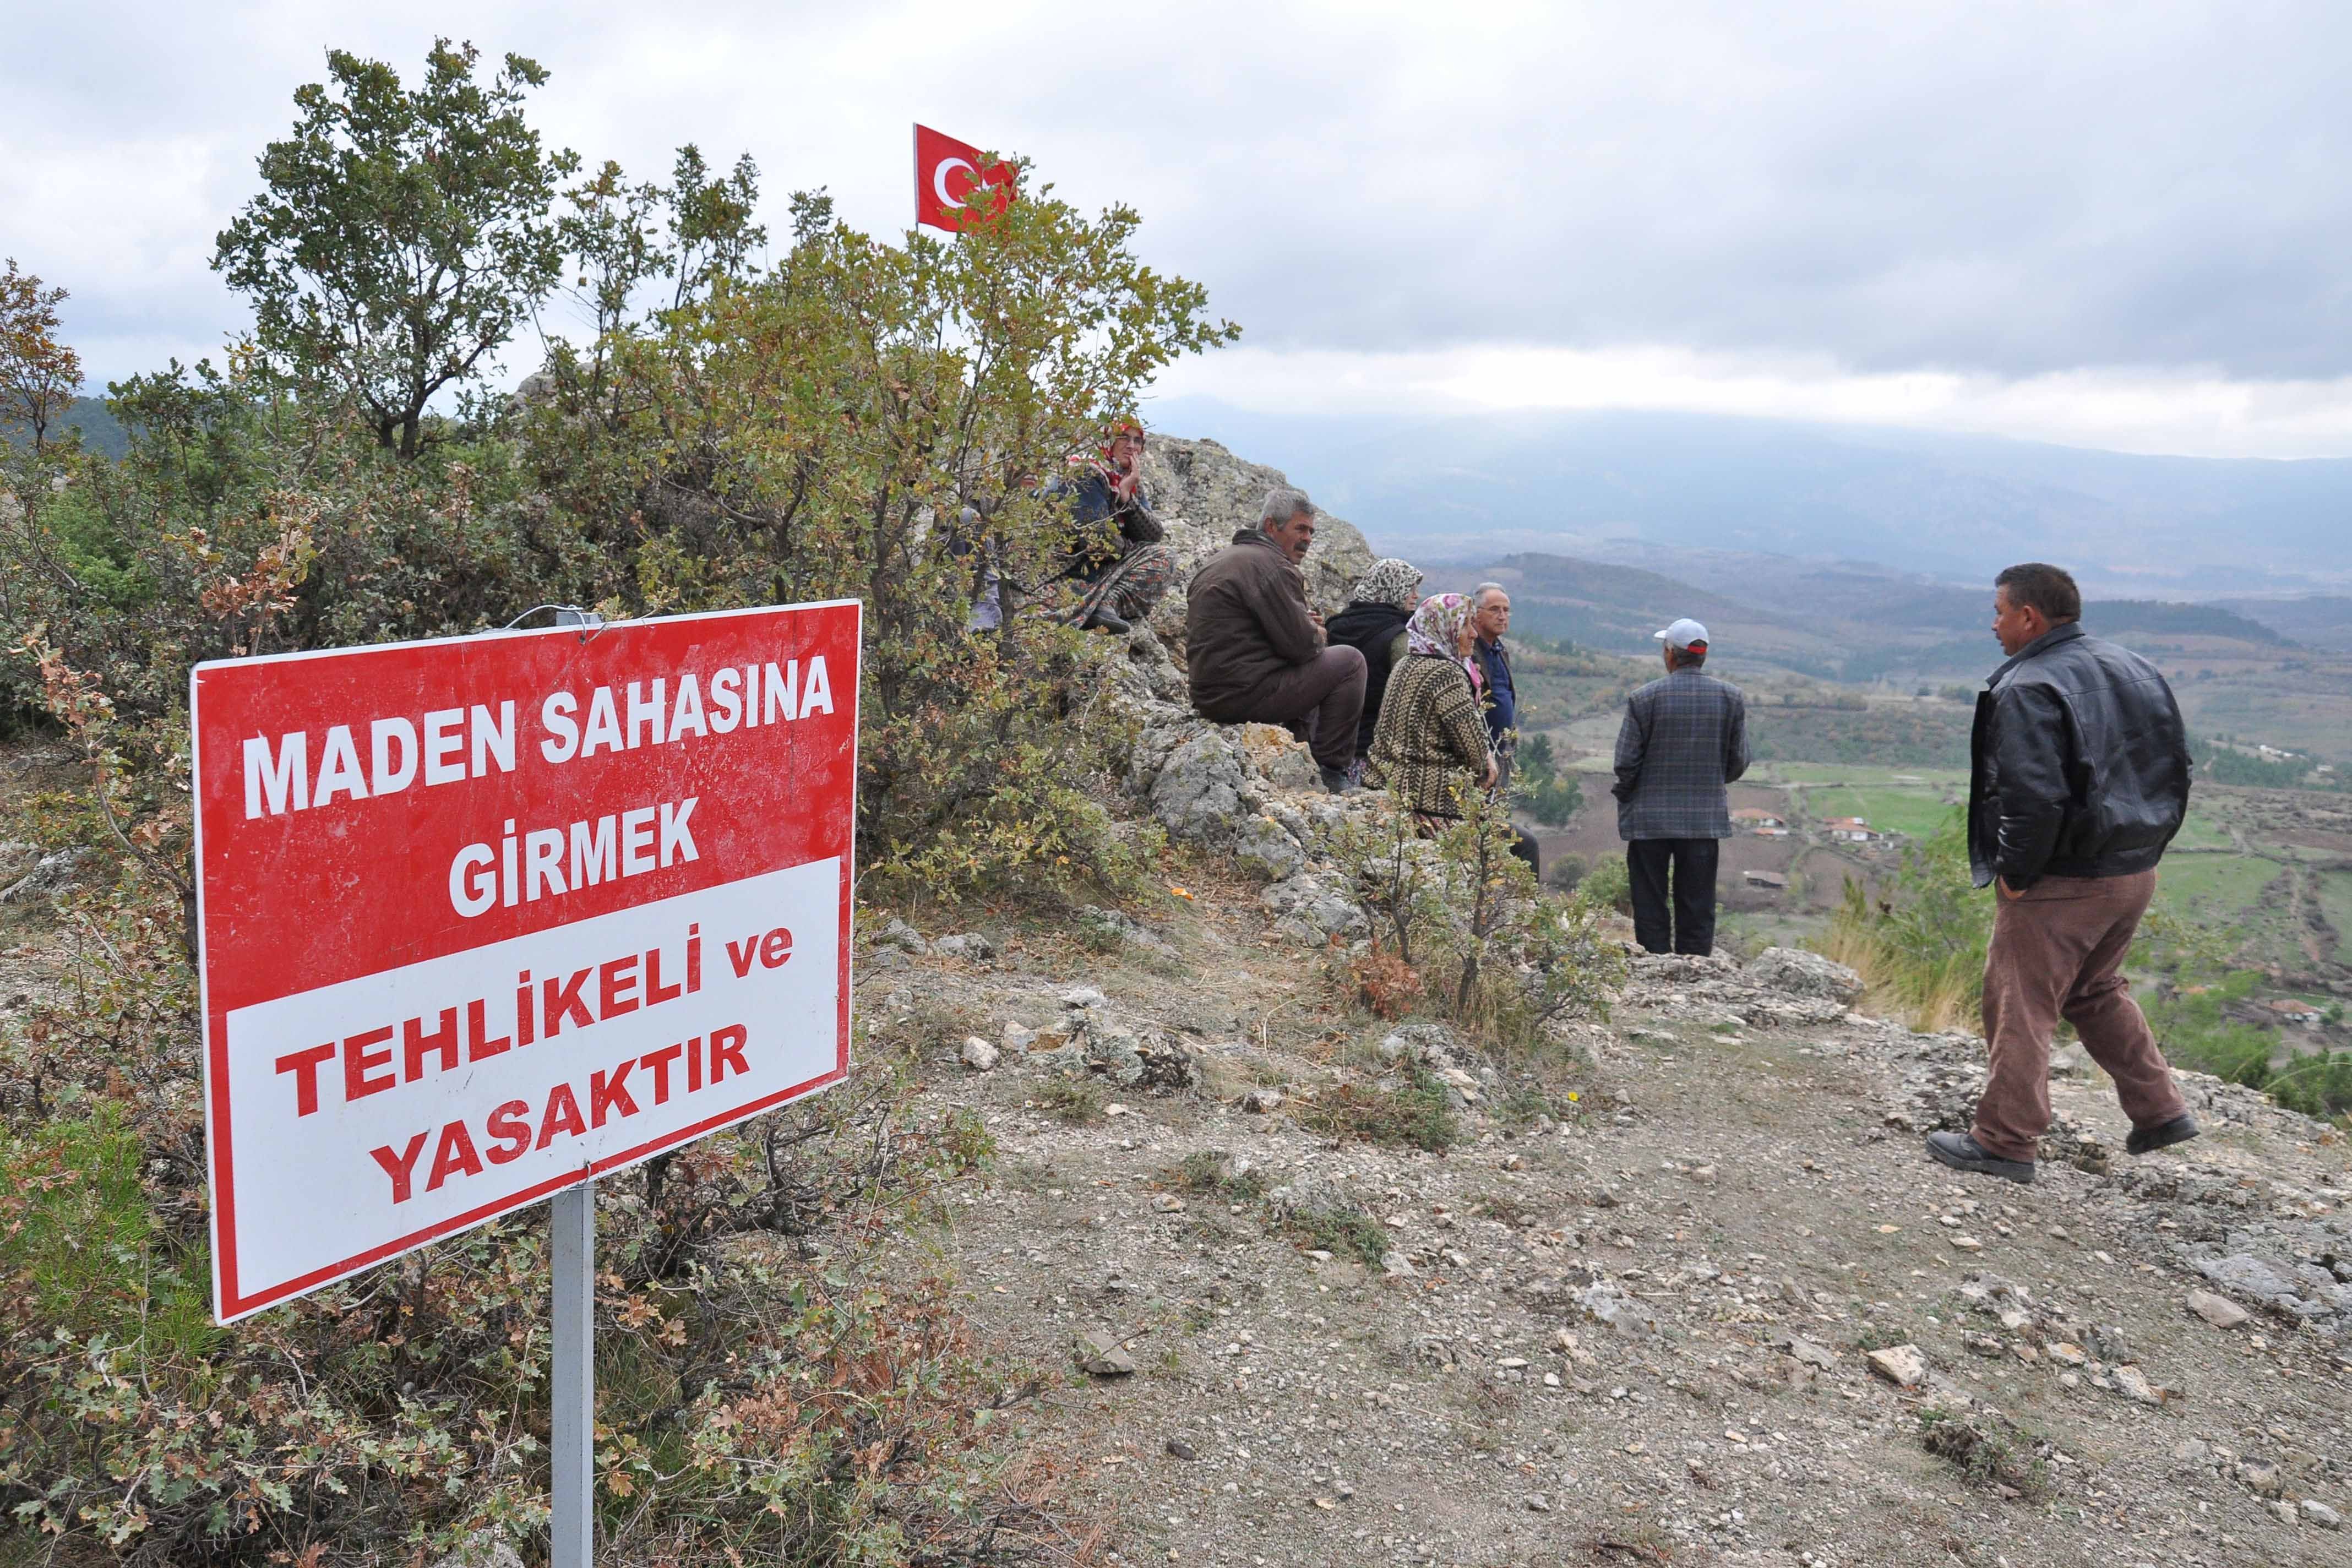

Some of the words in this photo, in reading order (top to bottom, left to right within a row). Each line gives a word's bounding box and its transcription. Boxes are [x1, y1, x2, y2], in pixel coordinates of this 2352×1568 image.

[243, 700, 516, 820] MADEN
[540, 655, 834, 764] SAHASINA
[449, 797, 700, 918] GİRMEK
[275, 923, 701, 1117] TEHLİKELİ
[726, 928, 793, 978] ve
[369, 1023, 750, 1205] YASAKTIR
